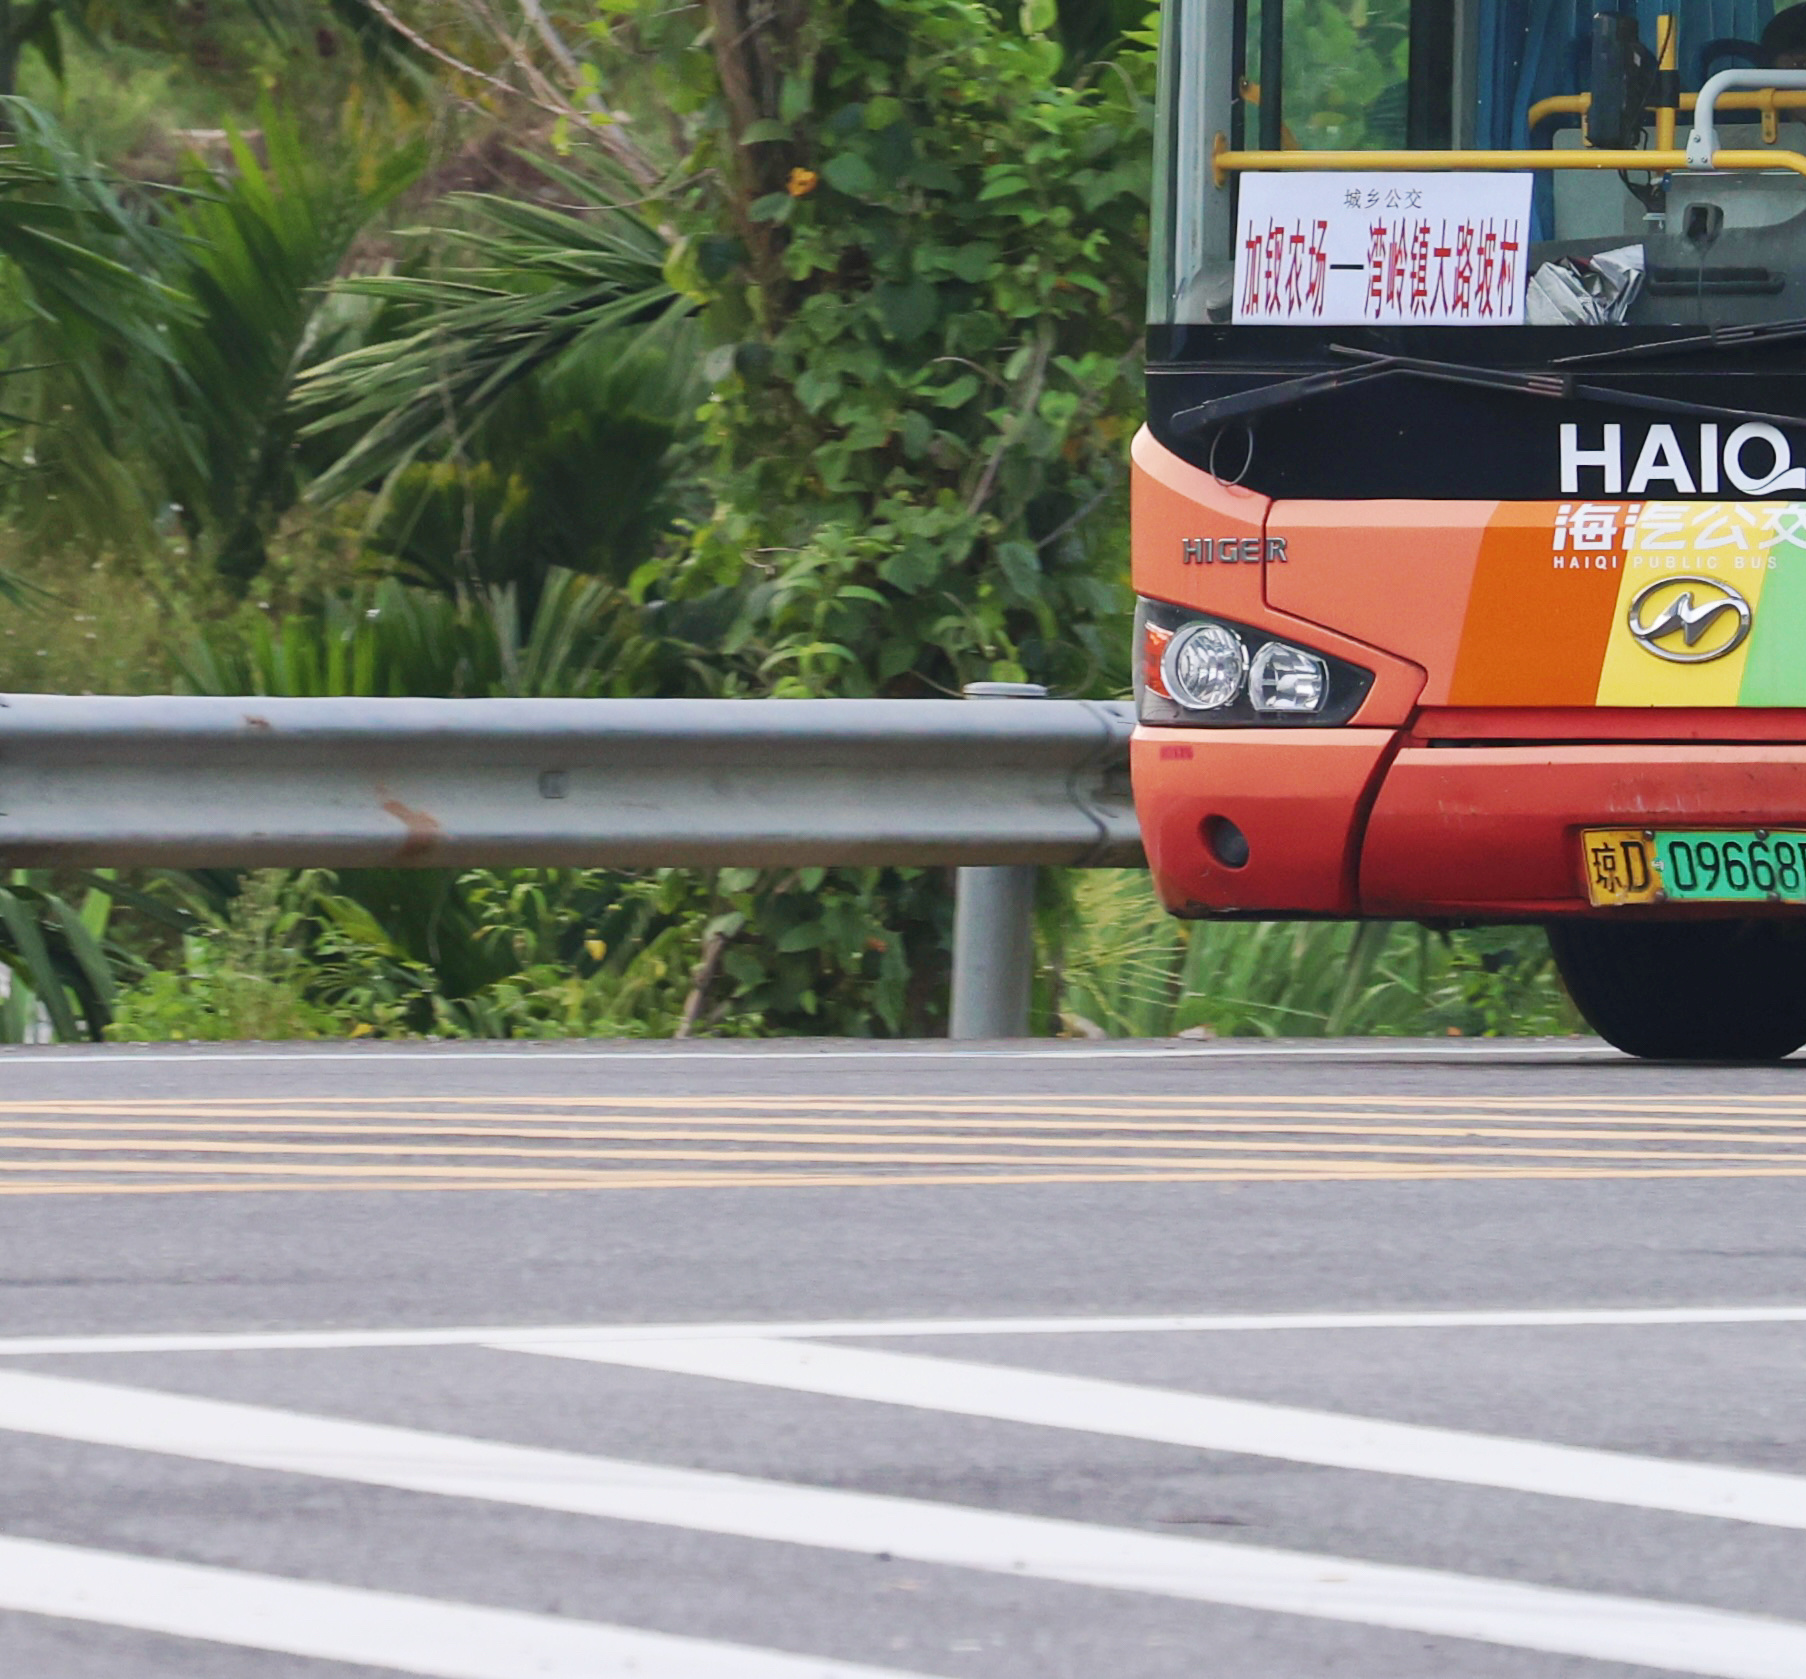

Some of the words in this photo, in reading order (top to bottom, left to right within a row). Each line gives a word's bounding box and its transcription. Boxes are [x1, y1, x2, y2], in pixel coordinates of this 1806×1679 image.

[1343, 188, 1423, 209] 城乡公交
[1182, 537, 1289, 564] HIGER
[1553, 555, 1618, 569] HAIQI
[1633, 555, 1718, 569] PUBLIC
[1734, 555, 1778, 569] BUS
